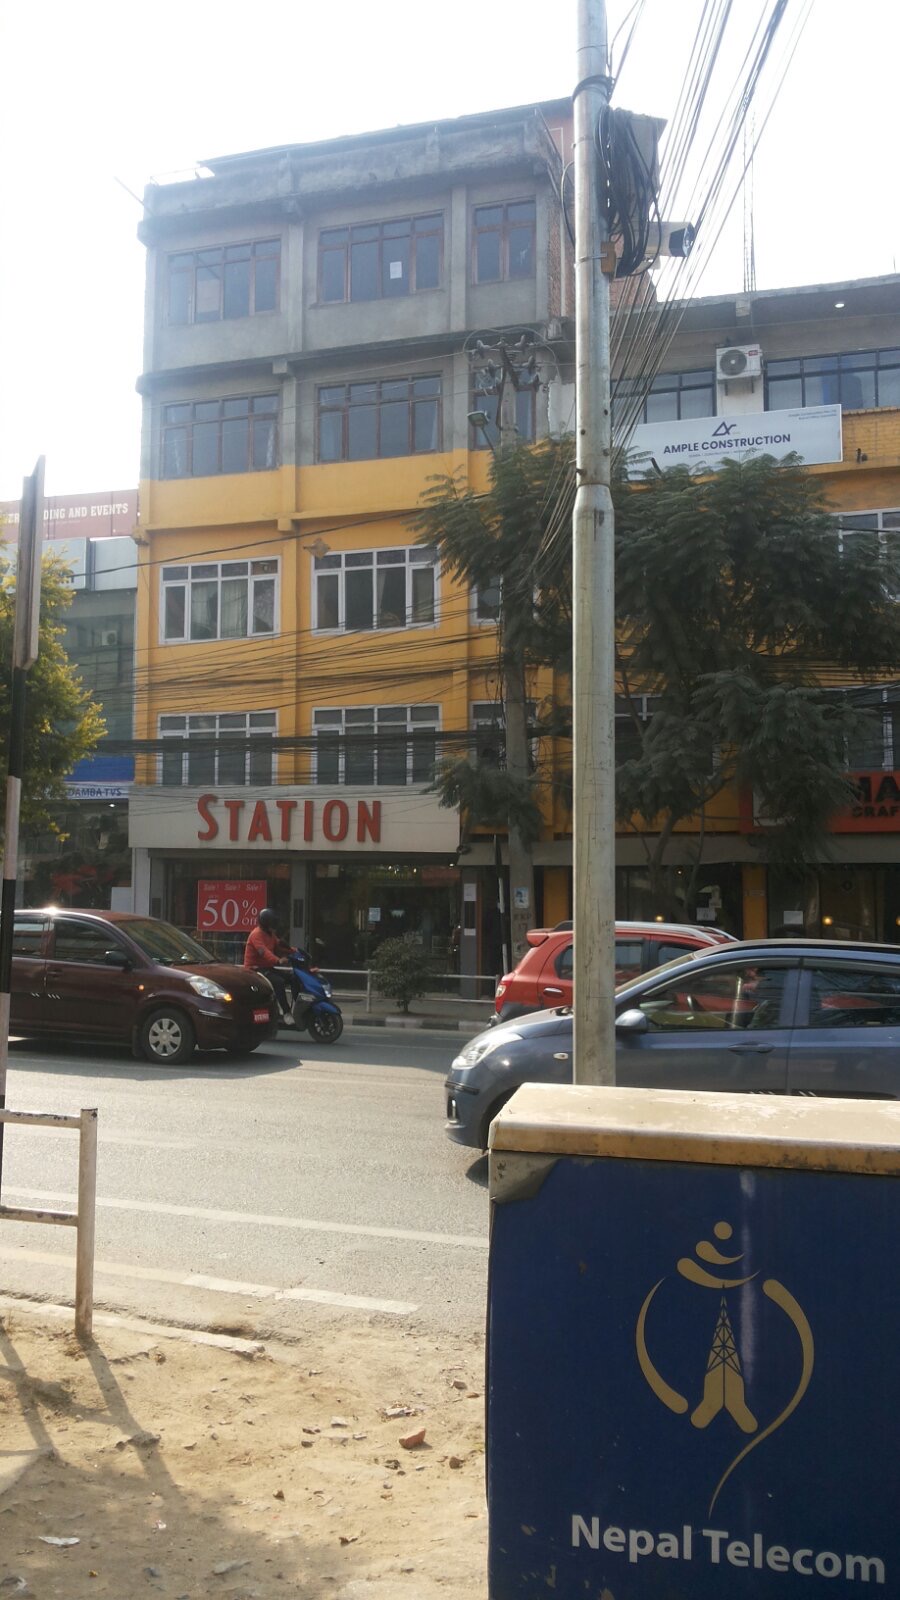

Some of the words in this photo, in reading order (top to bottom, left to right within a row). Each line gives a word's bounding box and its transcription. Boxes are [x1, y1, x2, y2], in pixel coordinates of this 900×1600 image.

[663, 442, 699, 454] AMPLE
[701, 434, 791, 451] CONSTRUCTION
[68, 506, 88, 519] AND
[90, 502, 129, 517] EVENTS
[197, 794, 382, 843] STATION
[571, 1514, 692, 1563] Nepal
[702, 1529, 885, 1584] Telecom
